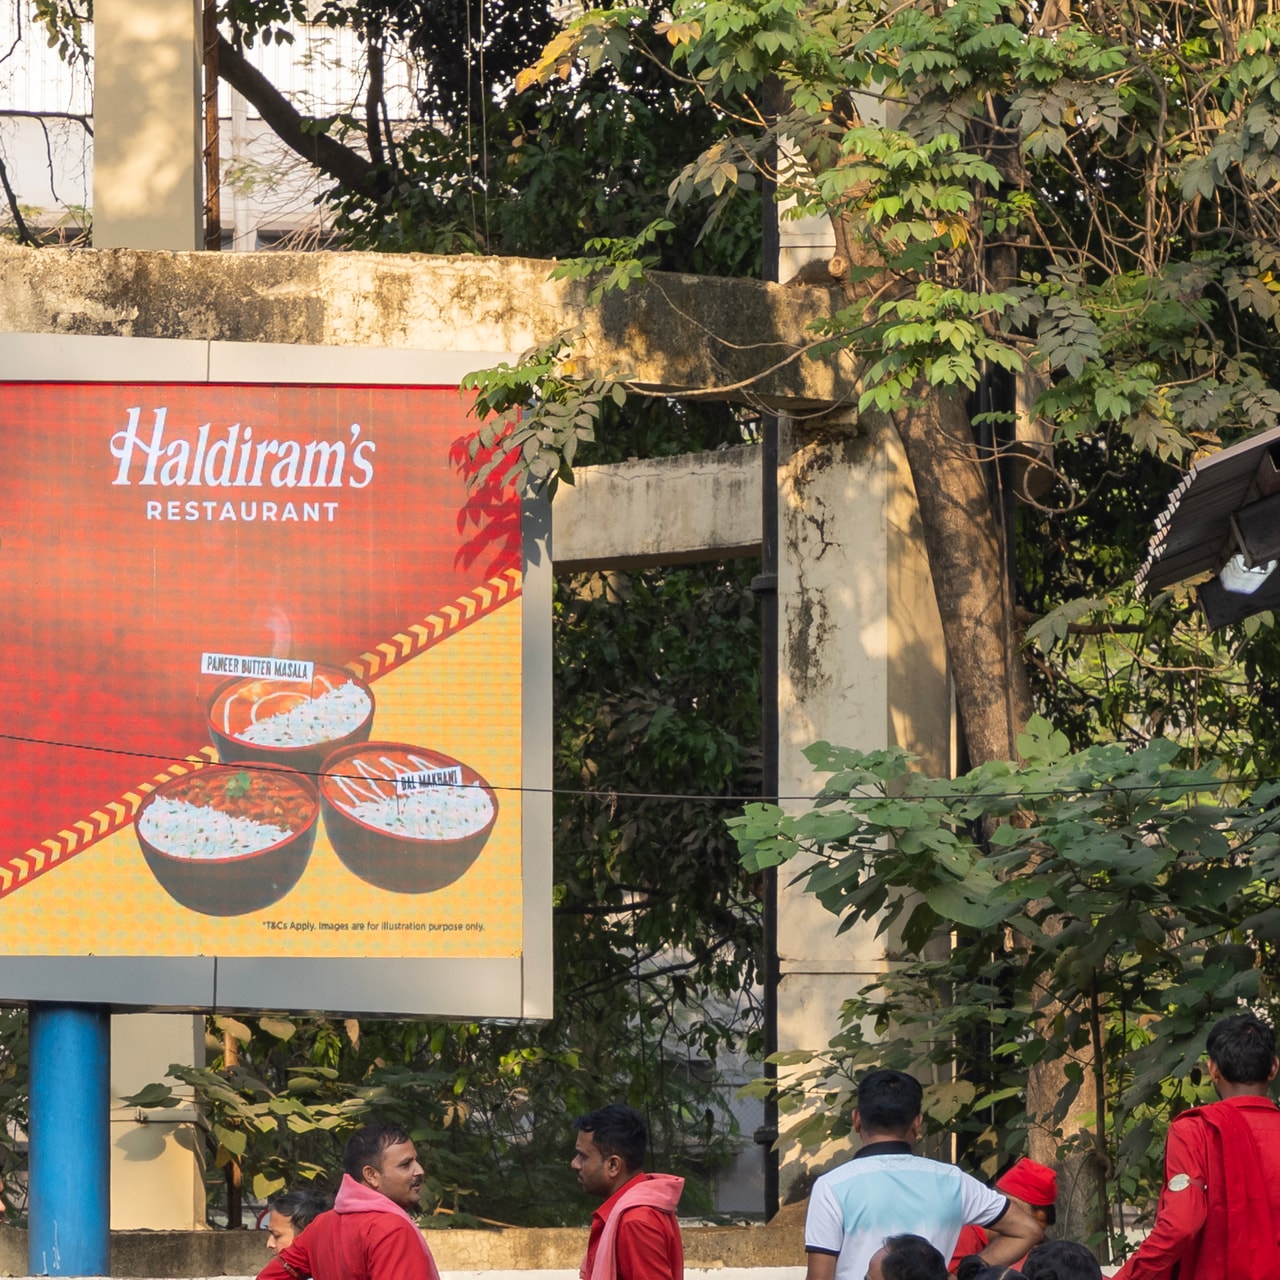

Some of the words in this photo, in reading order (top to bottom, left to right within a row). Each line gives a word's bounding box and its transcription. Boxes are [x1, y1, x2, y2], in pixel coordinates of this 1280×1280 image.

[110, 407, 376, 488] Haldiram's
[146, 500, 338, 522] RESTAURANT
[206, 655, 239, 673] PANEER
[241, 659, 272, 676] BUTTER
[274, 661, 308, 679] MASALA
[401, 775, 416, 791] DAL
[290, 921, 317, 932] Apply.
[319, 921, 349, 932] Images
[367, 921, 379, 931] for
[428, 923, 463, 933] purpose
[466, 921, 485, 932] only.
